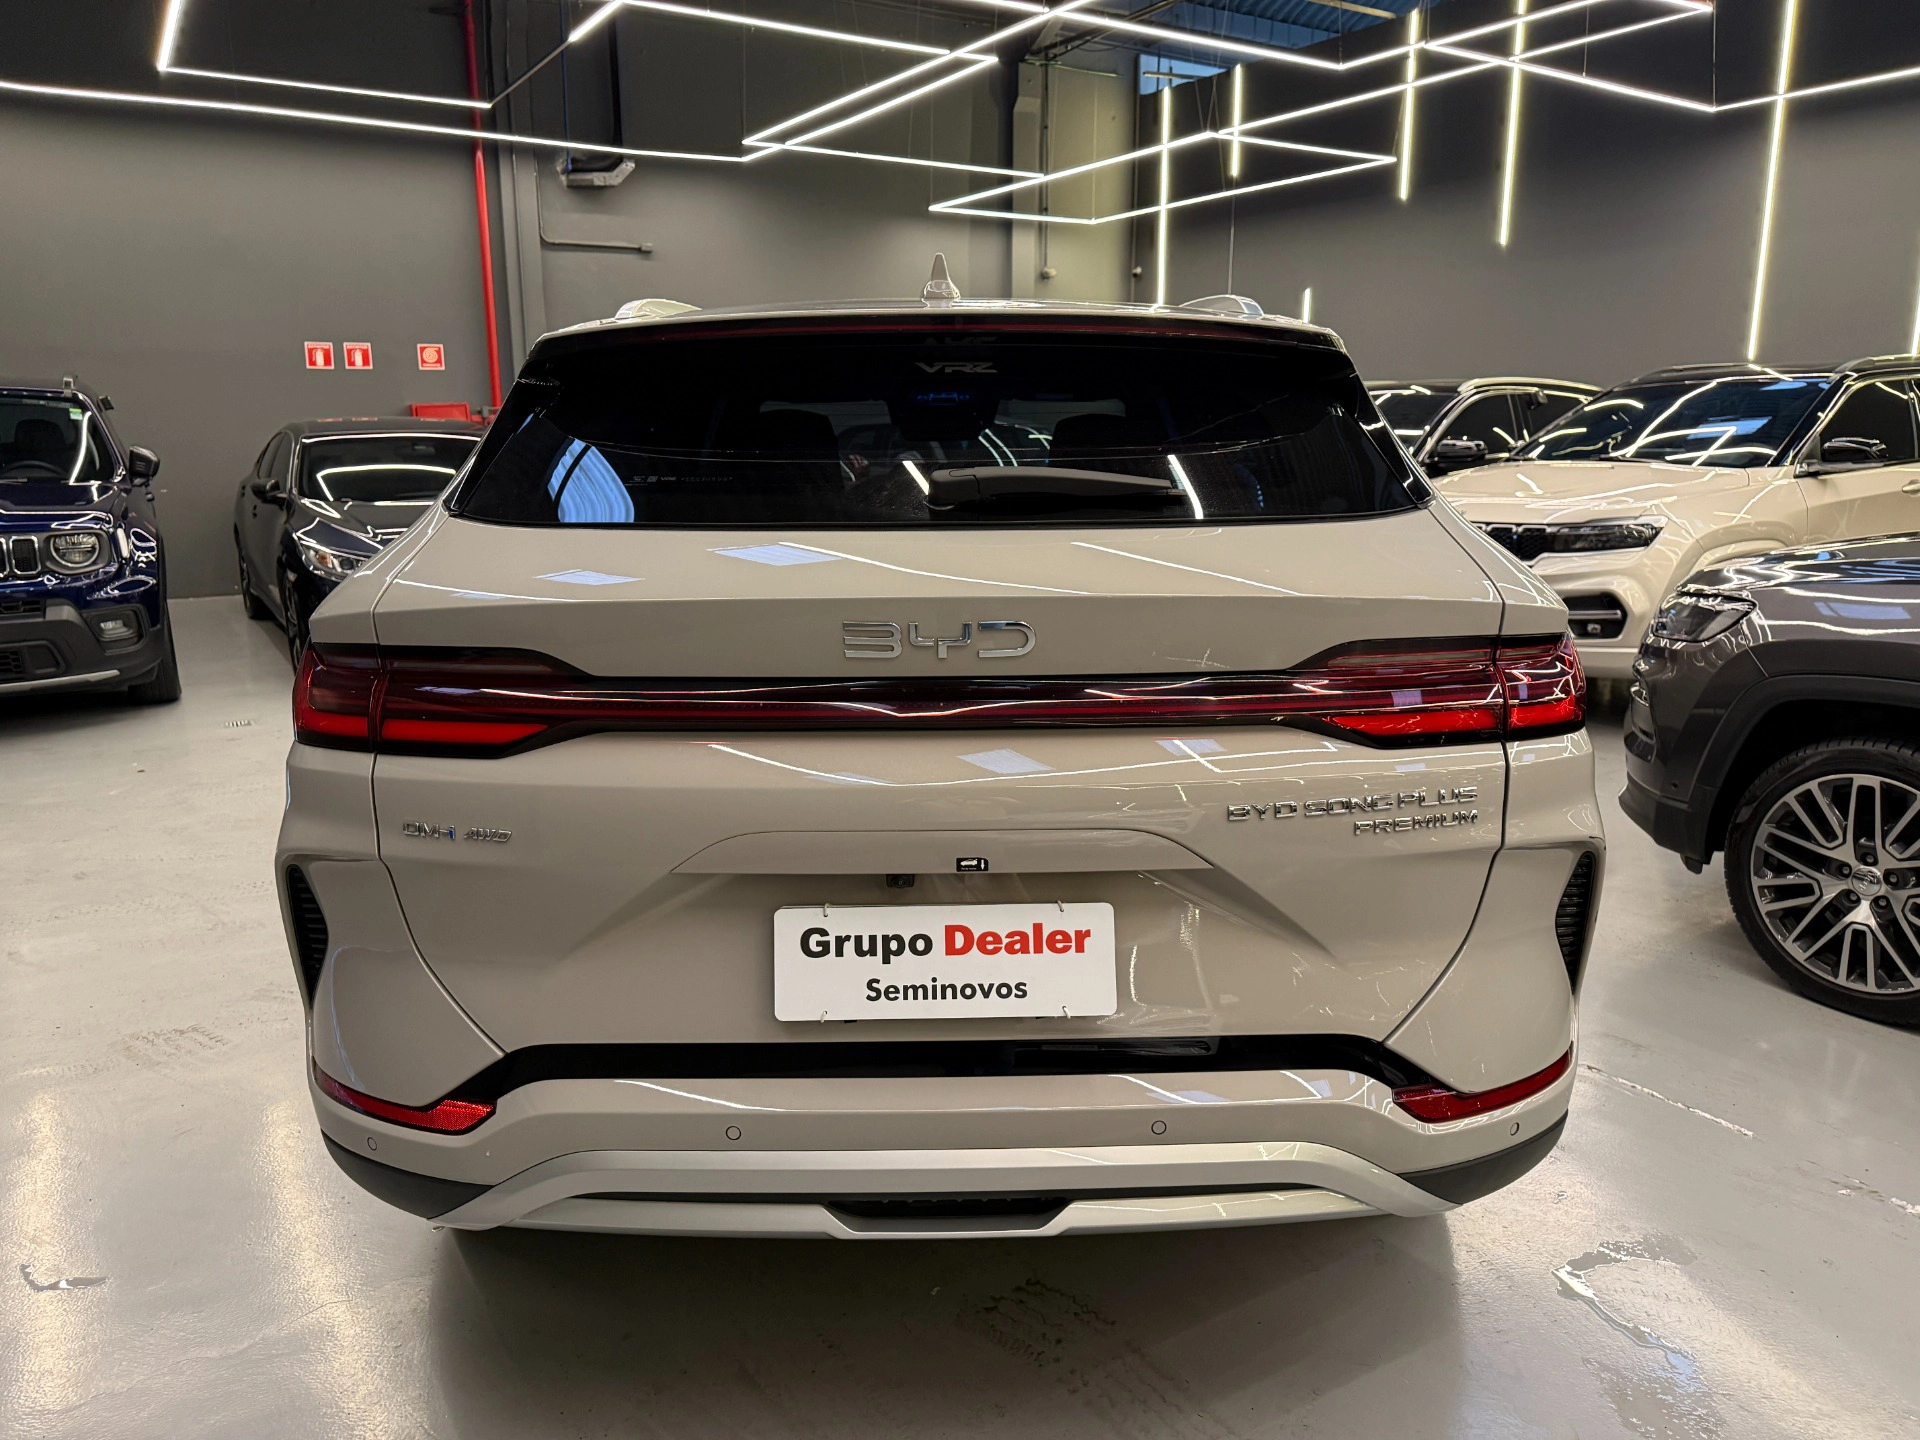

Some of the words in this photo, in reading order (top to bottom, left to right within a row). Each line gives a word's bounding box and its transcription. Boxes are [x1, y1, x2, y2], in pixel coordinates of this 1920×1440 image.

[843, 620, 1036, 659] BYD
[1228, 801, 1298, 821] BYD
[1304, 793, 1394, 816] SONG
[1398, 786, 1478, 807] PLUS
[463, 827, 512, 842] AWD
[1354, 809, 1478, 835] PREMIUM
[800, 927, 933, 964] Grupo
[944, 922, 1091, 956] Dealer
[865, 976, 1028, 1002] Seminovos
